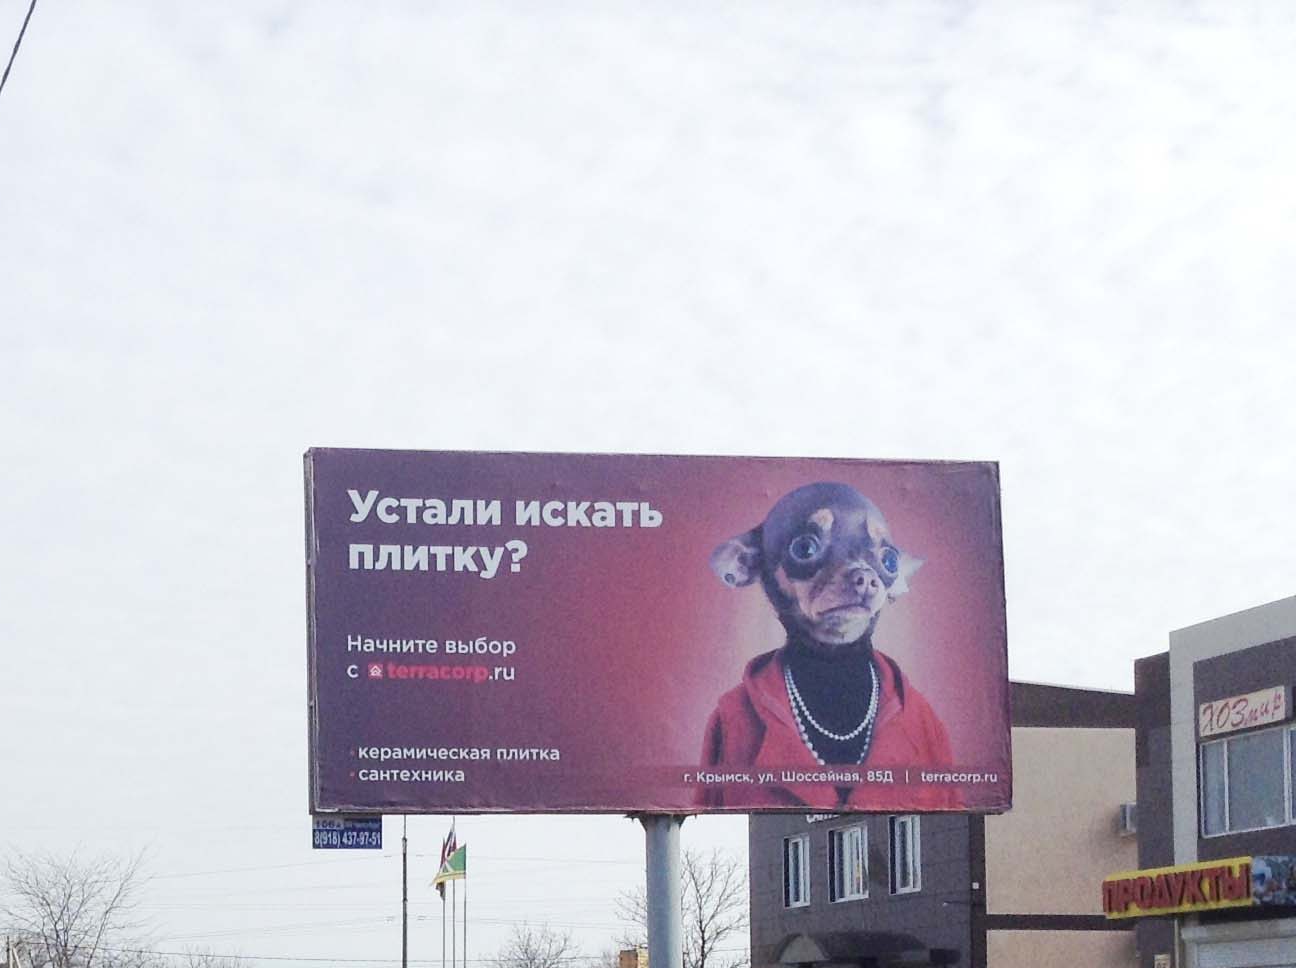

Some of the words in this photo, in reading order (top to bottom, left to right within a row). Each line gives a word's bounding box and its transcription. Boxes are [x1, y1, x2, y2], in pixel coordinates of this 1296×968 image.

[347, 489, 501, 526] Устали
[515, 500, 663, 528] искать
[349, 540, 528, 579] плитку?
[347, 634, 438, 654] Начните
[445, 637, 516, 656] выбор
[347, 665, 359, 678] с
[387, 663, 516, 682] terracorp.ru
[358, 747, 491, 763] керамическая
[497, 747, 560, 761] плитка
[358, 768, 465, 782] сантехника
[684, 774, 693, 783] г.
[697, 772, 753, 785] Крымск,
[758, 774, 777, 785] ул.
[781, 771, 863, 785] Шоссейная,
[867, 771, 894, 785] 85Д
[921, 772, 998, 785] terracorp.ru
[1103, 862, 1251, 913] ПРОДУКТЫ
